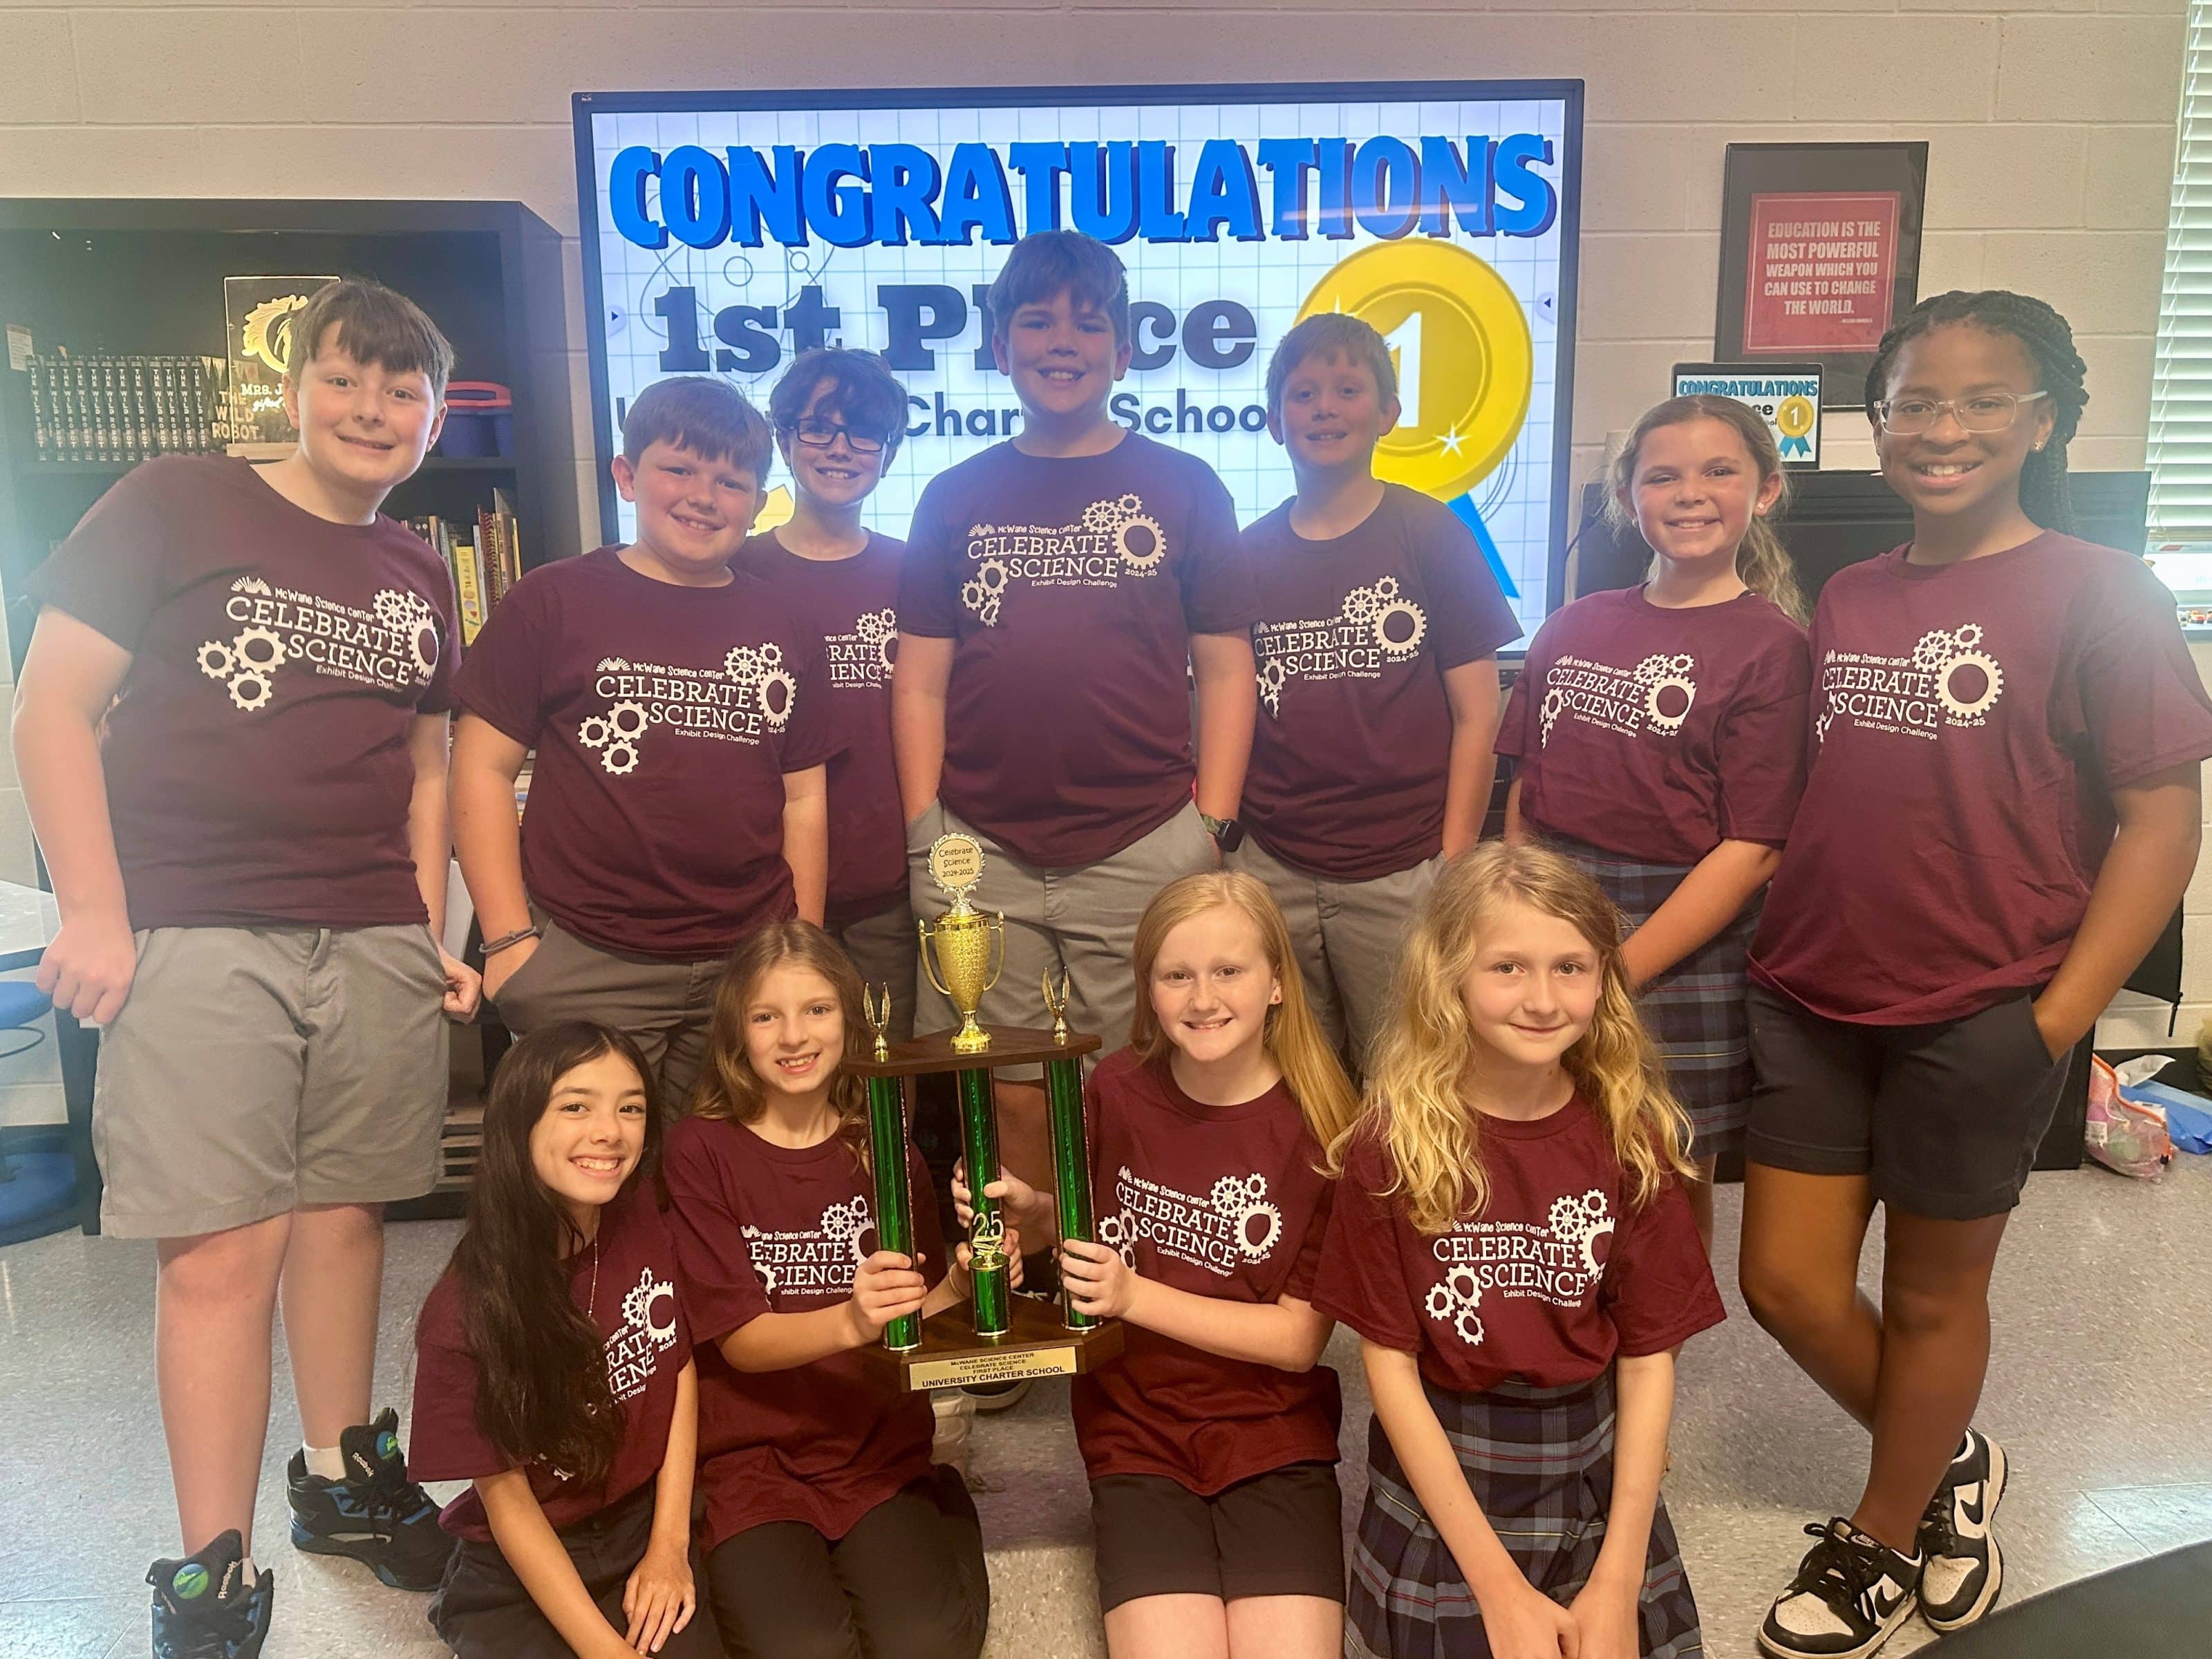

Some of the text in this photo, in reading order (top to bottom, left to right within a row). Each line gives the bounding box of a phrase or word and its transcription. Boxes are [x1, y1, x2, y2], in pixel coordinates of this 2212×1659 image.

[609, 133, 1557, 250] CONGRATULATIONS
[1768, 221, 1880, 238] EDUCATION IS THE
[1766, 242, 1878, 259] MOST POWERFUL
[1766, 262, 1877, 276] WEAPON WHICH YOU
[1764, 281, 1876, 296] CAN USE TO CHANGE
[1784, 299, 1854, 315] THE WORLD.
[654, 284, 841, 373] 1st
[1678, 380, 1818, 397] CONGRATULATIONS
[905, 388, 1266, 437] Char Schoo
[1790, 406, 1799, 426] 1
[1029, 525, 1057, 535] Science
[968, 535, 1109, 559] CELEBRATE
[1009, 557, 1119, 578] SCIENCE
[1125, 568, 1157, 577] 2024-25
[1031, 579, 1055, 587] Exhibit
[1083, 579, 1117, 588] Challenge
[275, 588, 312, 604] McWane
[315, 595, 345, 615] Science
[226, 596, 406, 656] CELEBRATE
[1271, 621, 1297, 632] McWane
[1299, 619, 1325, 630] Science
[1255, 626, 1368, 657] CELEBRATE
[288, 635, 415, 685] SCIENCE
[633, 662, 666, 675] McWane
[668, 666, 697, 677] Science
[1286, 648, 1380, 675] SCIENCE
[1837, 653, 1860, 662] McWane
[1861, 653, 1887, 666] Science
[316, 664, 346, 678] Exhibit
[348, 671, 375, 684] Design
[1822, 666, 1932, 698] CELEBRATE
[596, 675, 753, 709] CELEBRATE
[1546, 668, 1645, 704] CELEBRATE
[649, 702, 763, 735] SCIENCE
[1563, 689, 1645, 729] SCIENCE
[1835, 692, 1938, 728] SCIENCE
[1573, 713, 1591, 723] Exhibit
[1591, 717, 1610, 728] Design
[1854, 719, 1938, 740] Exhibit Design Challenge
[1944, 717, 1986, 728] 2024-25
[675, 729, 759, 745] Exhibit Design Challenge
[939, 847, 973, 857] Celebrate
[943, 868, 974, 877] 2024-2025
[944, 859, 971, 868] Science
[1134, 1177, 1159, 1192] McWane
[1159, 1185, 1185, 1201] Science
[1116, 1182, 1232, 1240] CELEBRATE
[774, 1231, 798, 1240] Science
[1463, 1223, 1494, 1232] McWane
[1496, 1221, 1523, 1232] Science
[1138, 1217, 1239, 1268] SCIENCE
[1433, 1237, 1577, 1268] CELEBRATE
[1157, 1246, 1180, 1258] Exhibit
[1181, 1253, 1203, 1266] Design
[1479, 1263, 1588, 1296] SCIENCE
[1527, 1290, 1550, 1302] Design
[922, 1366, 1065, 1387] UNIVERSITY CHARTER SCHOOL
